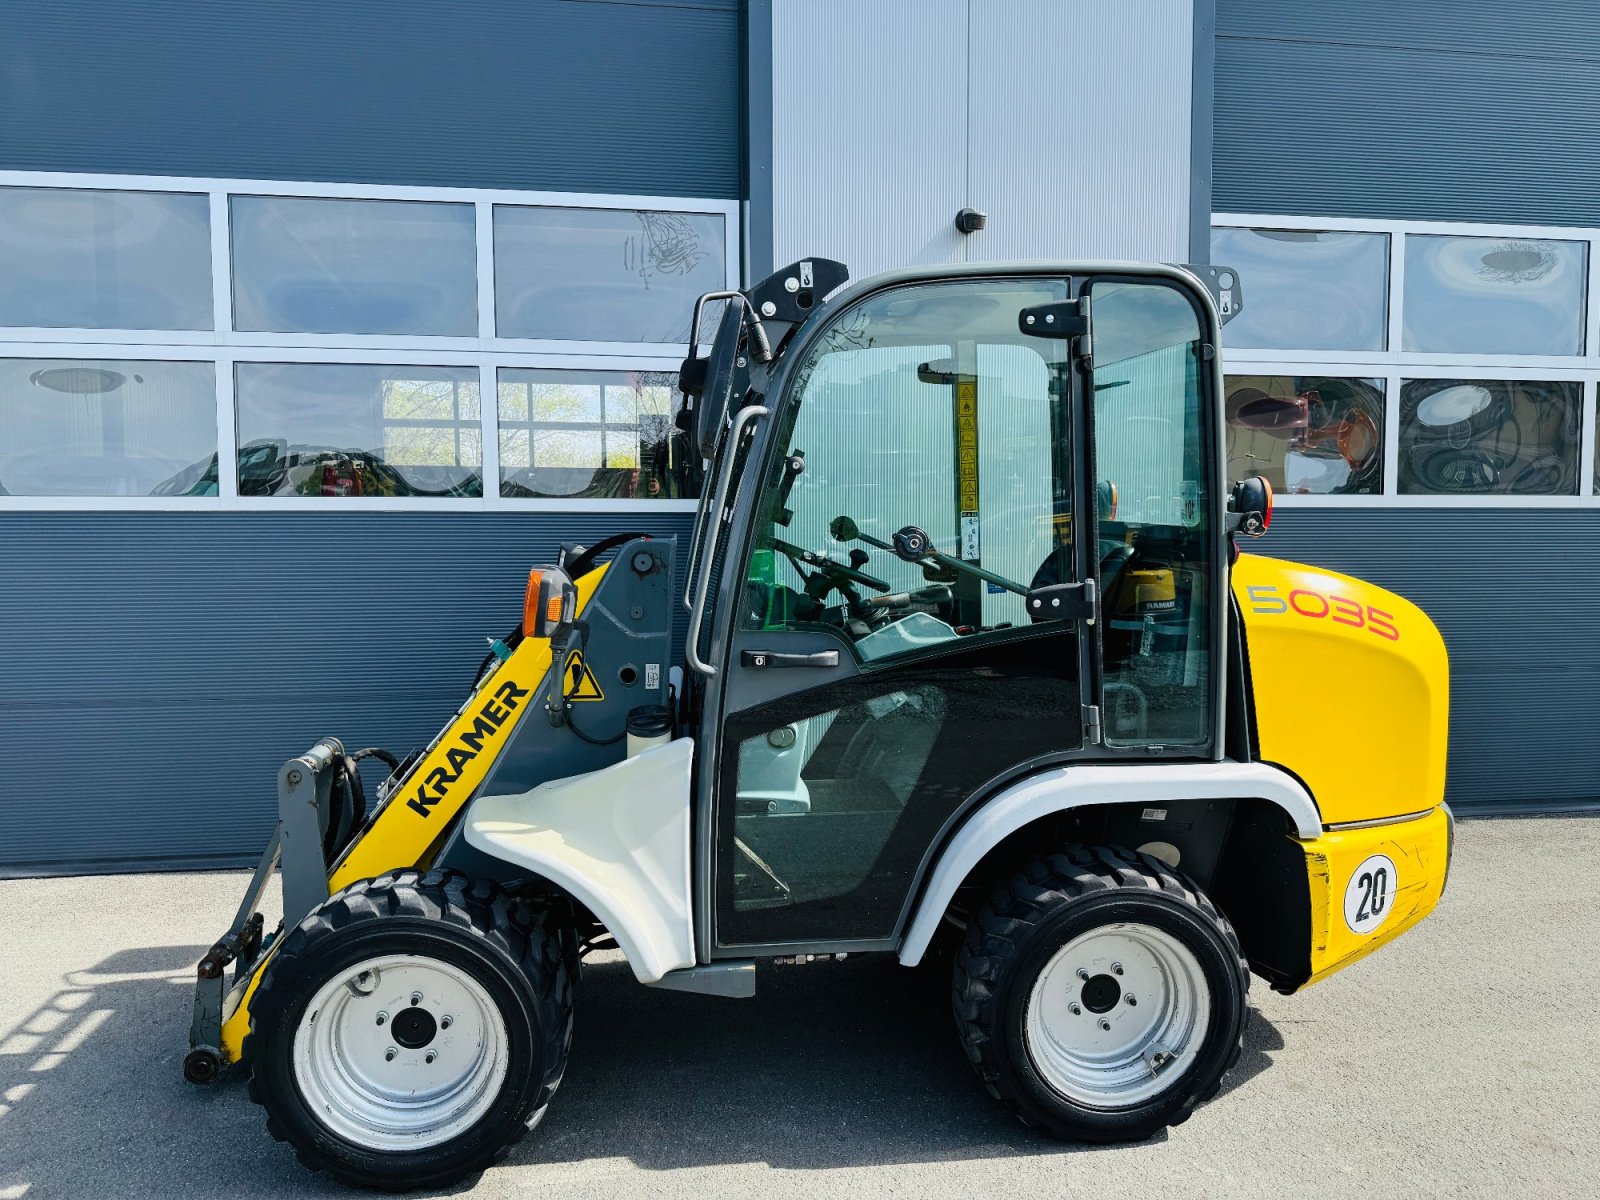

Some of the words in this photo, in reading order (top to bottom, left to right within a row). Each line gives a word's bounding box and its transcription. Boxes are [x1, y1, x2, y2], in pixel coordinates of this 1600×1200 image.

[1247, 586, 1399, 641] 5035
[406, 680, 530, 818] KRAMER
[1355, 867, 1387, 923] 20
